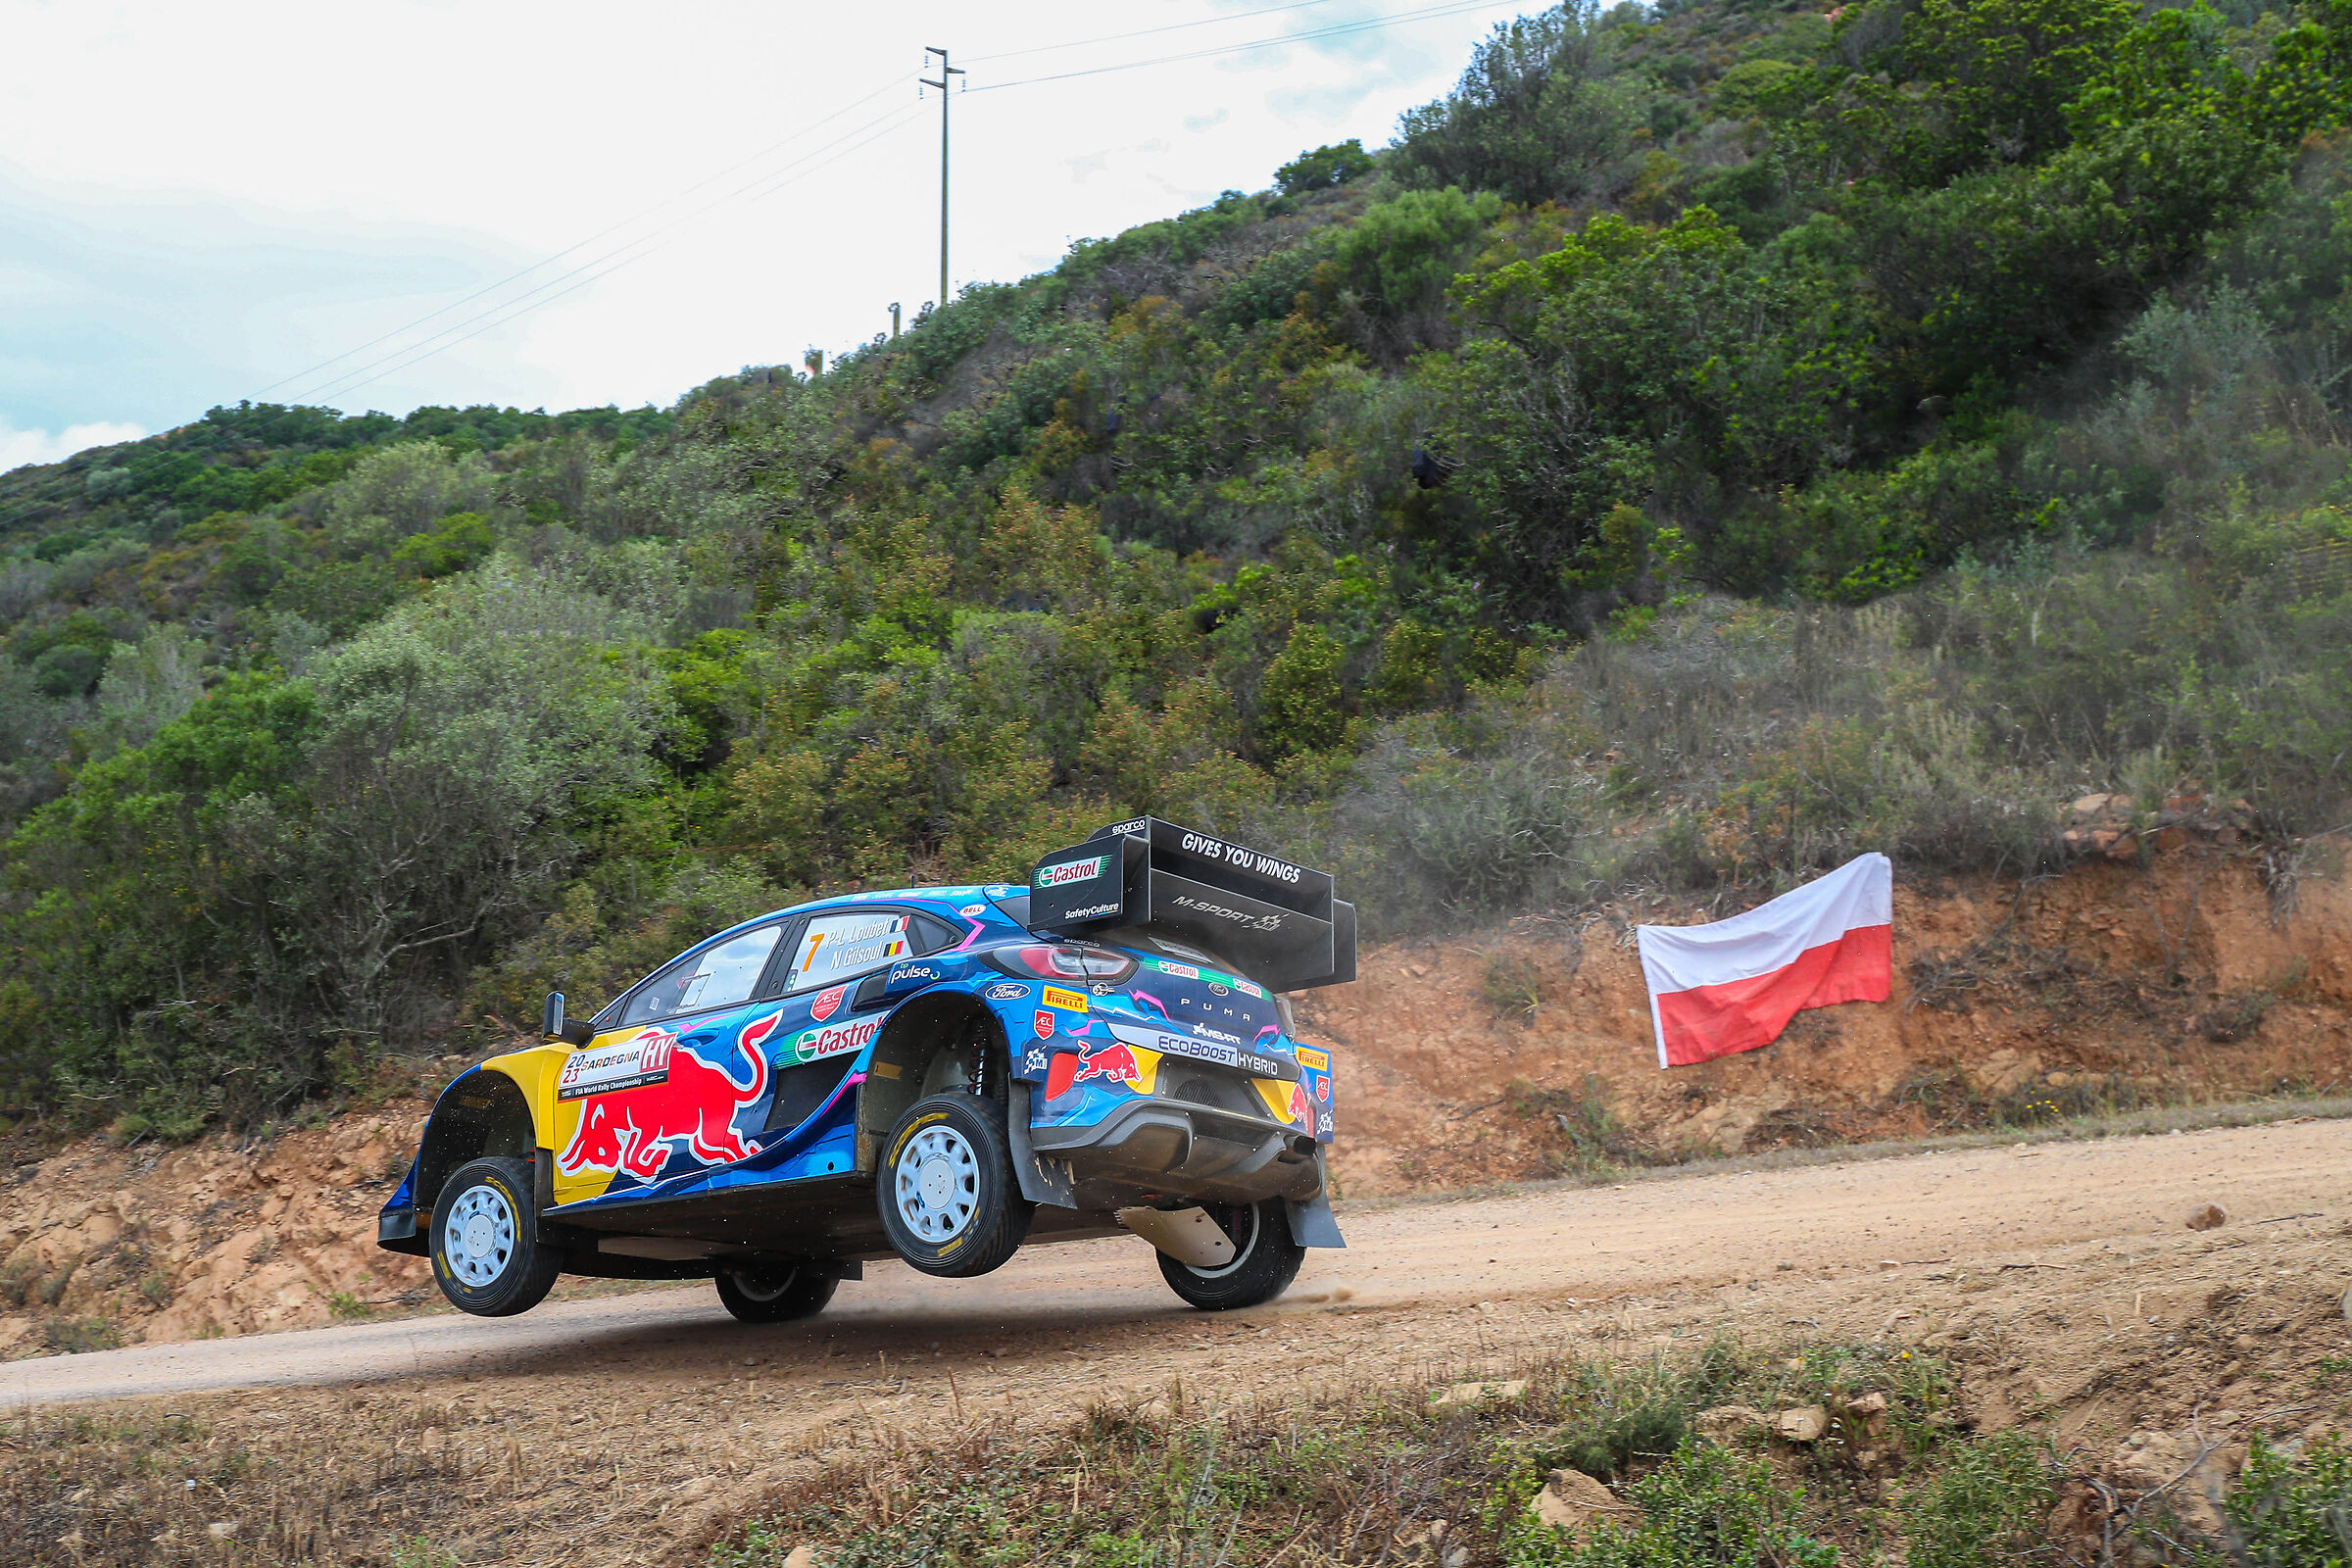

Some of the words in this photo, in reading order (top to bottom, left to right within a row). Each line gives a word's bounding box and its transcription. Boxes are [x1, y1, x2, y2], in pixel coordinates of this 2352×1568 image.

[1112, 819, 1146, 834] sparco
[1182, 833, 1222, 858] GIVES
[1225, 845, 1254, 868] YOU
[1255, 856, 1301, 884] WINGS
[1054, 859, 1097, 883] Castrol
[1064, 902, 1119, 920] SafetyCulture
[1172, 895, 1254, 923] M-SPORT
[825, 928, 846, 949] P-L
[848, 916, 890, 945] Loubet
[802, 933, 825, 972] 7
[830, 950, 844, 970] N
[845, 942, 885, 967] Gilsoul
[890, 964, 931, 984] pulse
[1168, 963, 1197, 978] Castrol
[992, 986, 1022, 998] Ford
[1047, 990, 1084, 1009] PIRELLI
[1180, 998, 1250, 1021] PUMA
[567, 1054, 586, 1069] 20
[581, 1051, 640, 1071] SARDEGNA
[642, 1036, 673, 1070] HY
[1298, 1051, 1325, 1067] PIRELLI
[1238, 1053, 1278, 1076] HYBRID
[563, 1067, 580, 1084] 23
